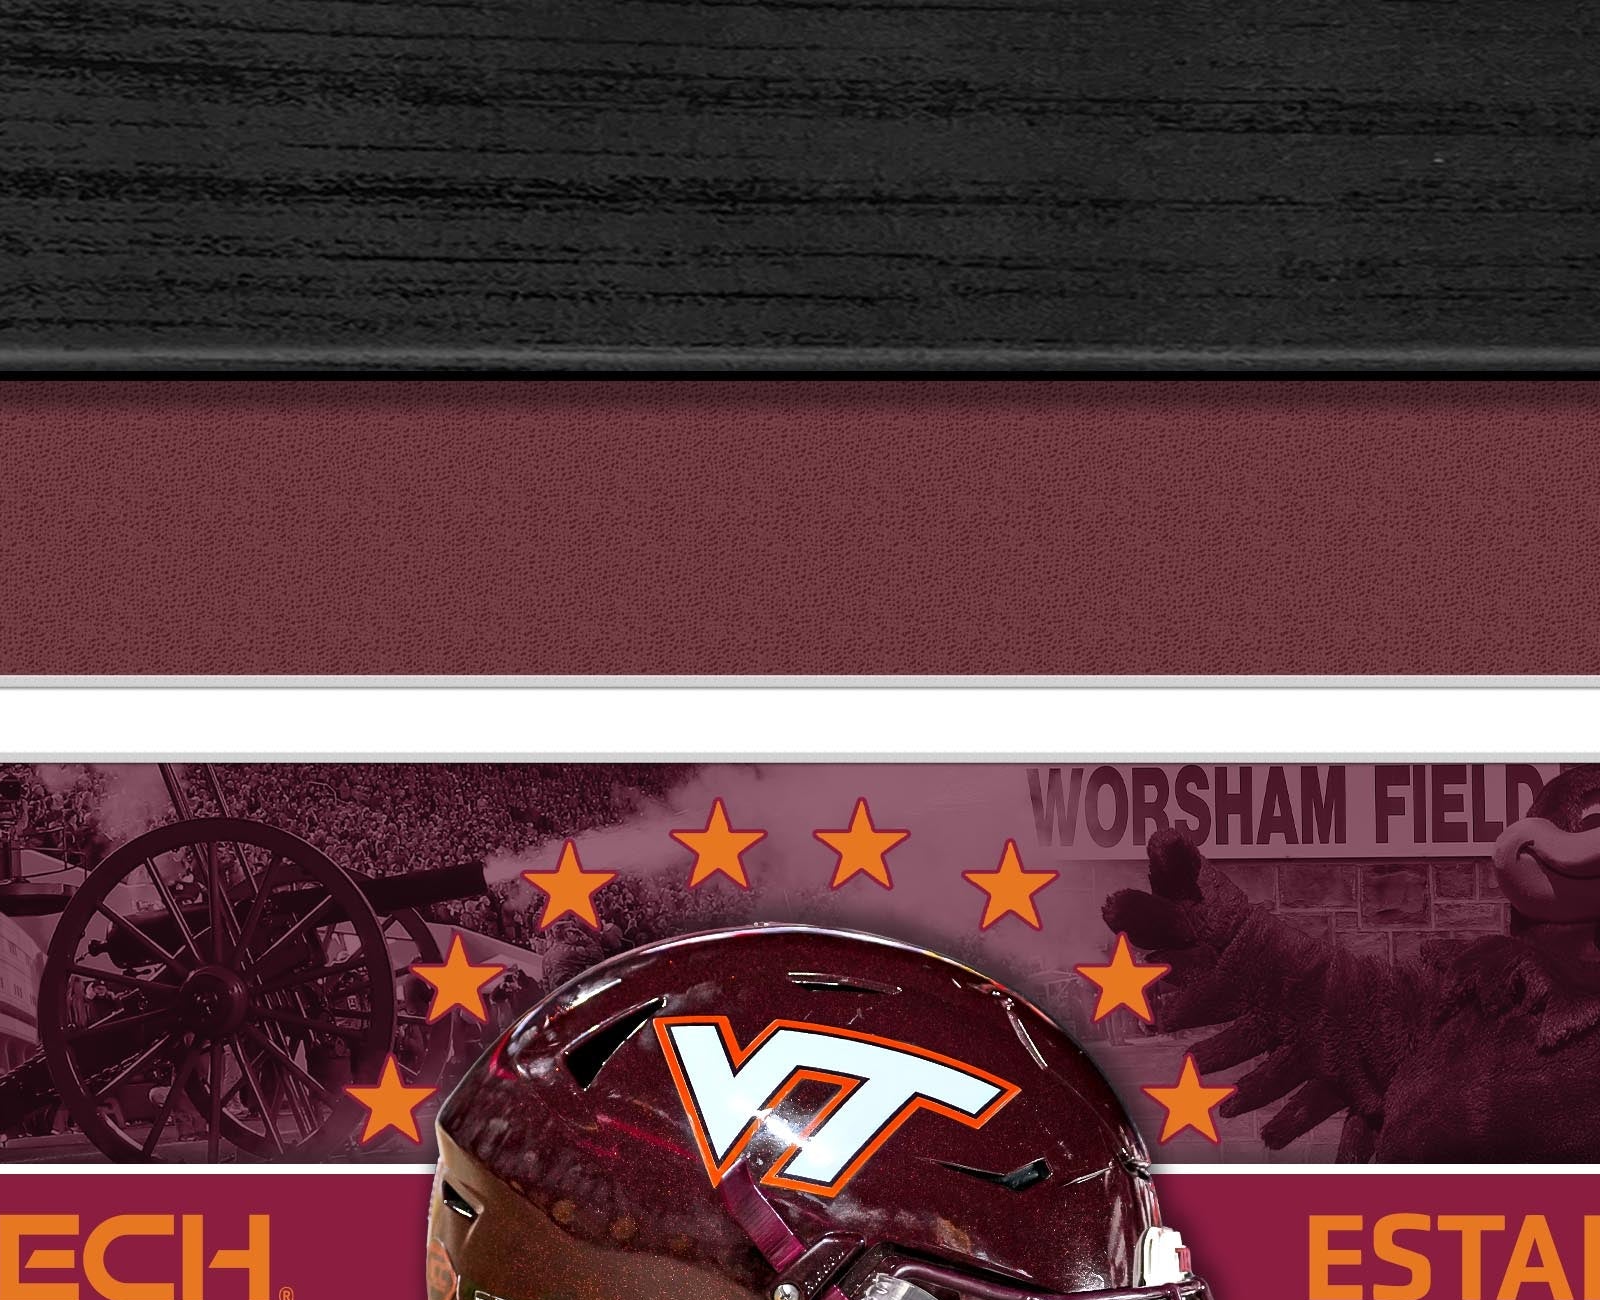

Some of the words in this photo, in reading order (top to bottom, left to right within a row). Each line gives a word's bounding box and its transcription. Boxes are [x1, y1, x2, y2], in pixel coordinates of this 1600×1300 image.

[1027, 764, 1347, 849] WORSHAM
[1374, 764, 1545, 844] FIELD
[653, 1015, 1021, 1199] VT
